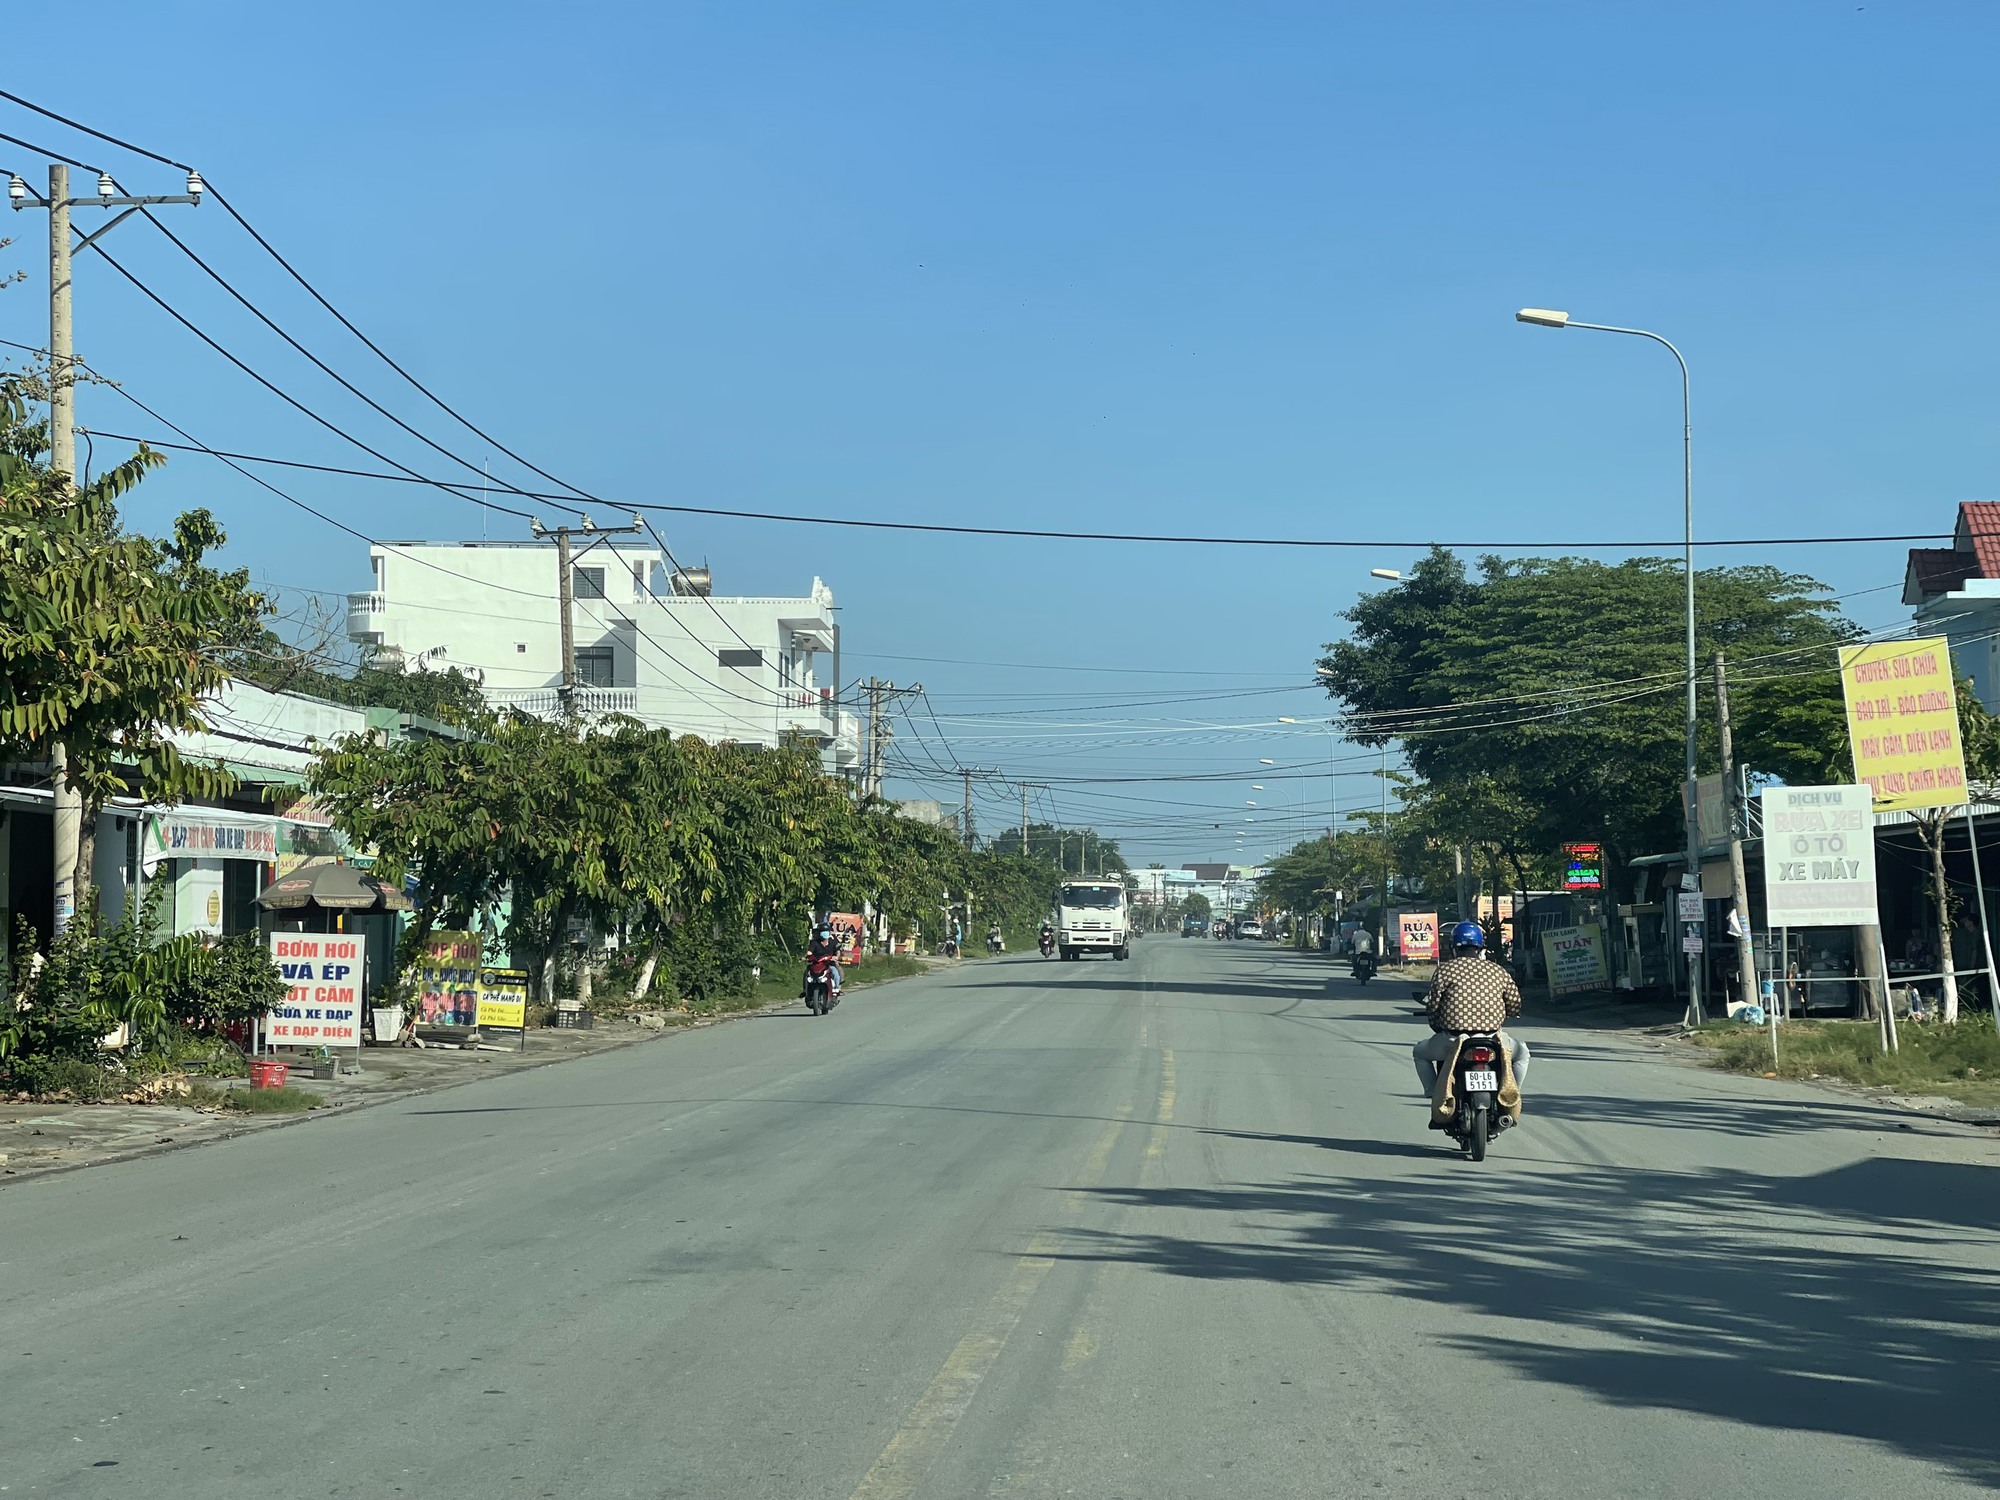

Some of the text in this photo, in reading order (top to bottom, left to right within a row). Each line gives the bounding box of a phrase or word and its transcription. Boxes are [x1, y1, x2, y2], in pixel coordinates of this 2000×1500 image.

[1929, 729, 1952, 754] LẠNH
[1908, 766, 1936, 791] CHÍNH
[1938, 763, 1962, 787] HÀNG
[1788, 792, 1842, 807] DỊCH VỤ
[1774, 808, 1863, 832] RỬA XE
[1793, 833, 1843, 854] Ô TÔ
[1779, 857, 1860, 881] XE MÁY
[1404, 919, 1433, 932] RỬA
[1410, 933, 1429, 942] XE
[1553, 934, 1592, 951] TUẤN
[277, 940, 356, 958] BƠM HƠI
[281, 962, 350, 980] VÁ ÉP
[315, 985, 354, 1003] CĂM
[274, 1006, 301, 1019] SỬA
[305, 1009, 321, 1019] XE
[273, 1025, 289, 1036] XE
[1470, 1072, 1492, 1080] 60-L6
[1470, 1081, 1493, 1090] 5151
